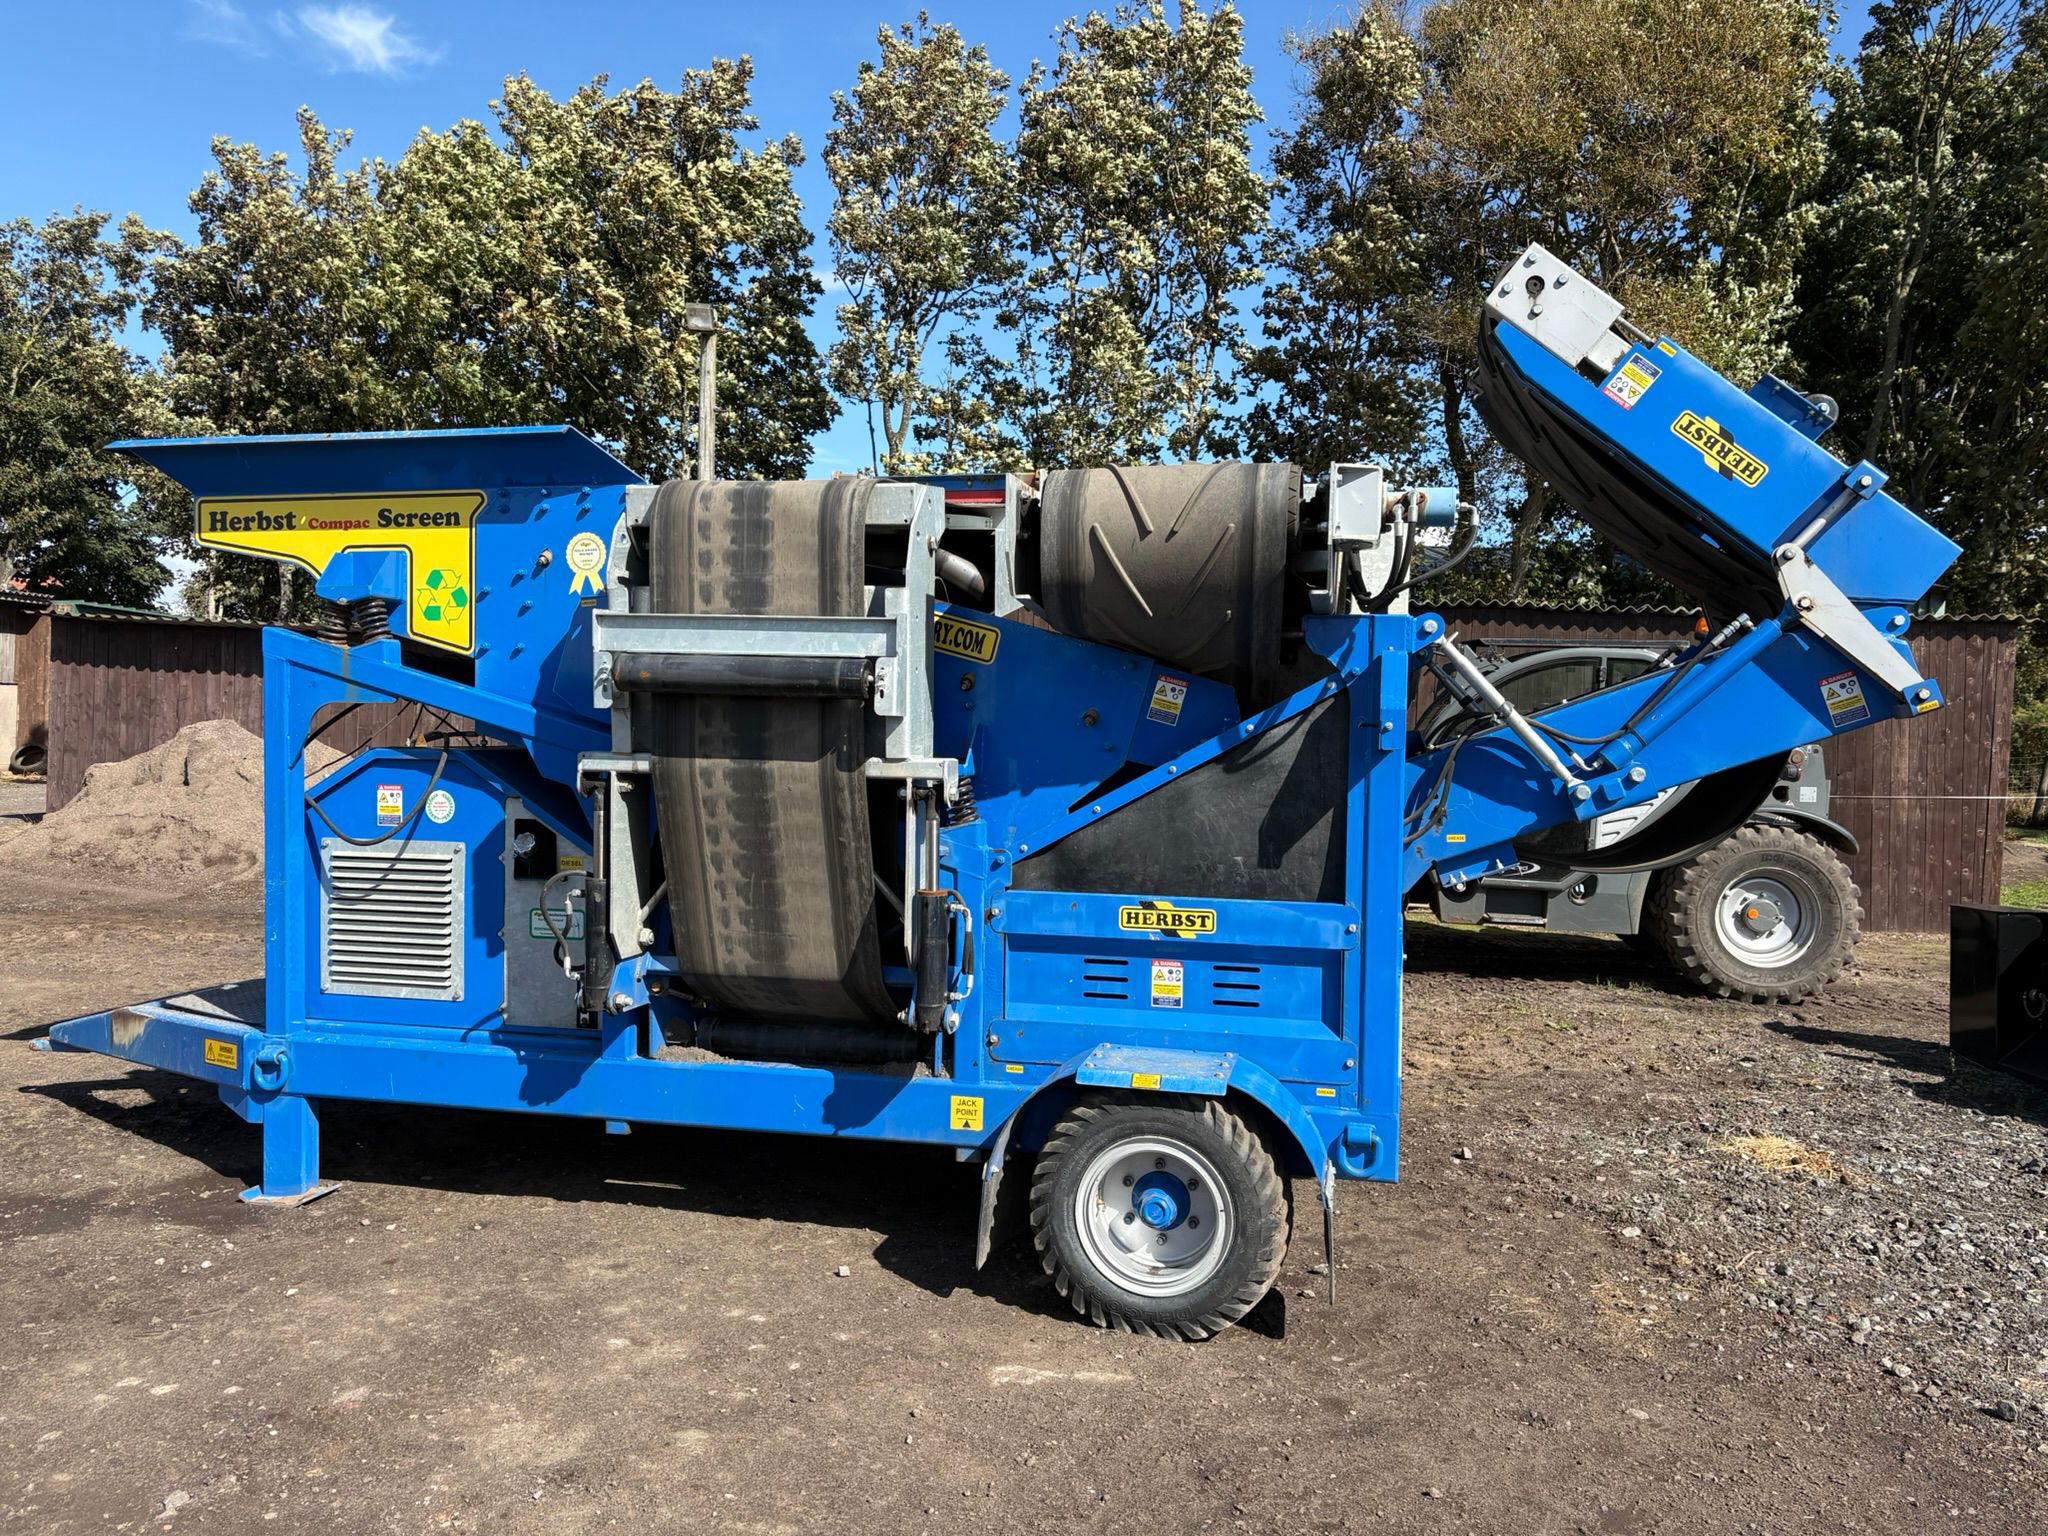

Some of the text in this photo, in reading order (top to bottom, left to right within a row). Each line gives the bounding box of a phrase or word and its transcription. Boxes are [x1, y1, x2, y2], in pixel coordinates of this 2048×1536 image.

[1679, 419, 1760, 480] HERBST
[208, 507, 461, 532] Herbst Compac Screen
[1125, 911, 1211, 928] HERBST
[957, 1098, 977, 1108] JACK
[955, 1108, 978, 1117] POINT
